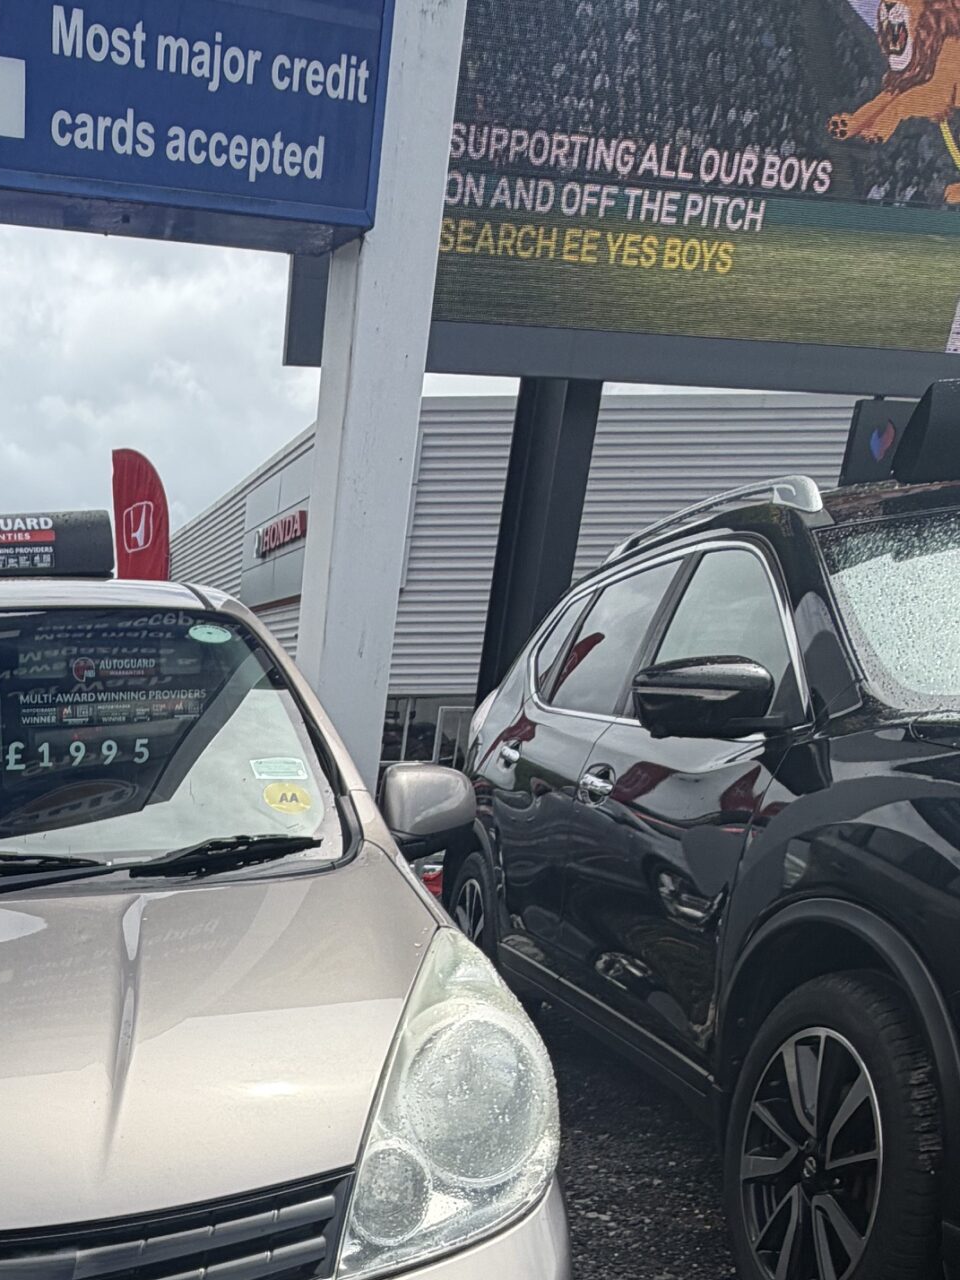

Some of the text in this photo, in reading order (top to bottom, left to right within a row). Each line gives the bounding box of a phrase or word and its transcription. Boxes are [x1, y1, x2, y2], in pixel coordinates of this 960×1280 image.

[51, 5, 370, 103] Most major credit
[51, 108, 325, 182] cards accepted
[450, 122, 833, 194] SUPPORTING ALL OUR BOYS
[445, 169, 766, 232] ON AND OFF THE PITCH
[440, 218, 735, 273] SEARCH EE YES BOYS
[15, 546, 54, 554] PROVIDERS
[262, 511, 301, 550] HONDA
[99, 658, 156, 670] AUTOGUARD
[20, 688, 207, 704] MULTI-AWARD WINNING PROVIDERS
[22, 715, 56, 724] WINNER
[279, 792, 299, 803] AA
